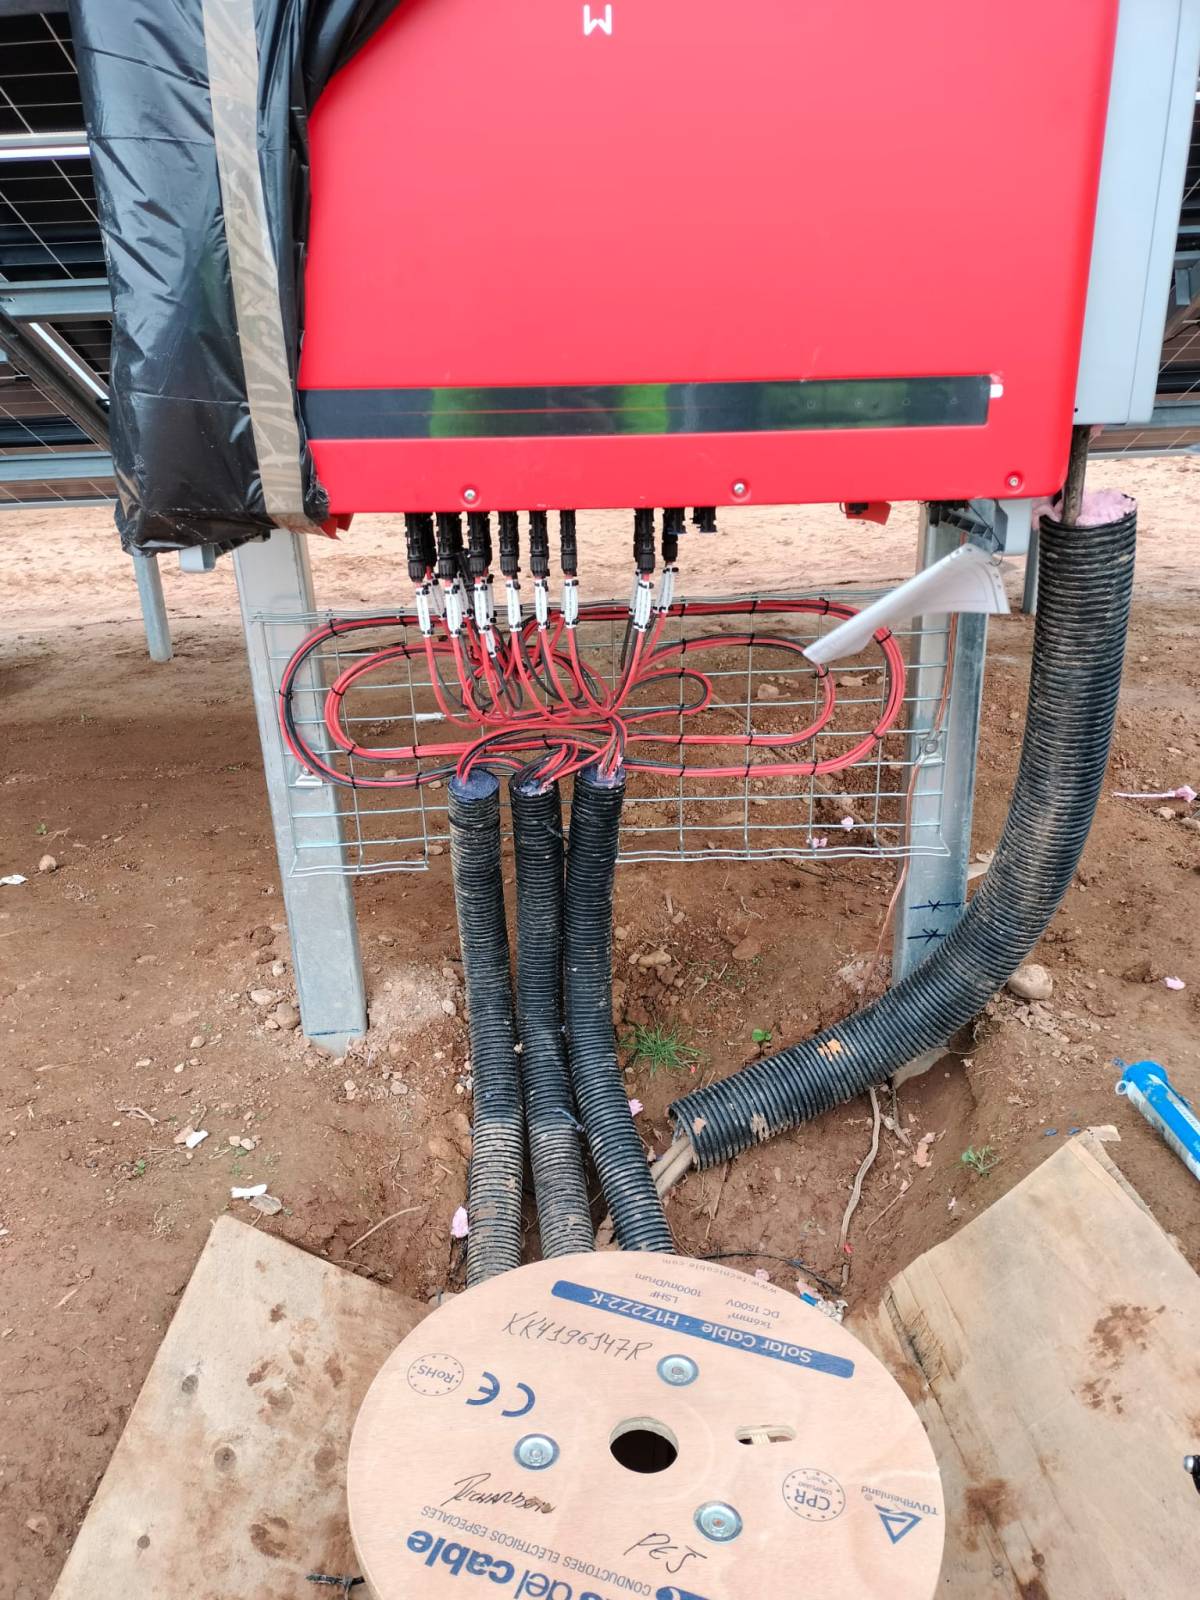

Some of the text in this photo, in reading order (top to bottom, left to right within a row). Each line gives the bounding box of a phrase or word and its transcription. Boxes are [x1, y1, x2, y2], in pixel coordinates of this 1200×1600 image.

[634, 1271, 702, 1298] 1000m/Drum
[590, 1291, 813, 1363] Solar Cable H1Z2Z2-K
[726, 1298, 780, 1319] DC 1500V
[418, 1364, 456, 1384] RoHS
[466, 1371, 536, 1418] CE
[794, 1488, 831, 1511] CPR
[406, 1530, 515, 1584] cable
[420, 1504, 652, 1596] CONDUCTORES ELÉCTRICOS ESPECIALES
